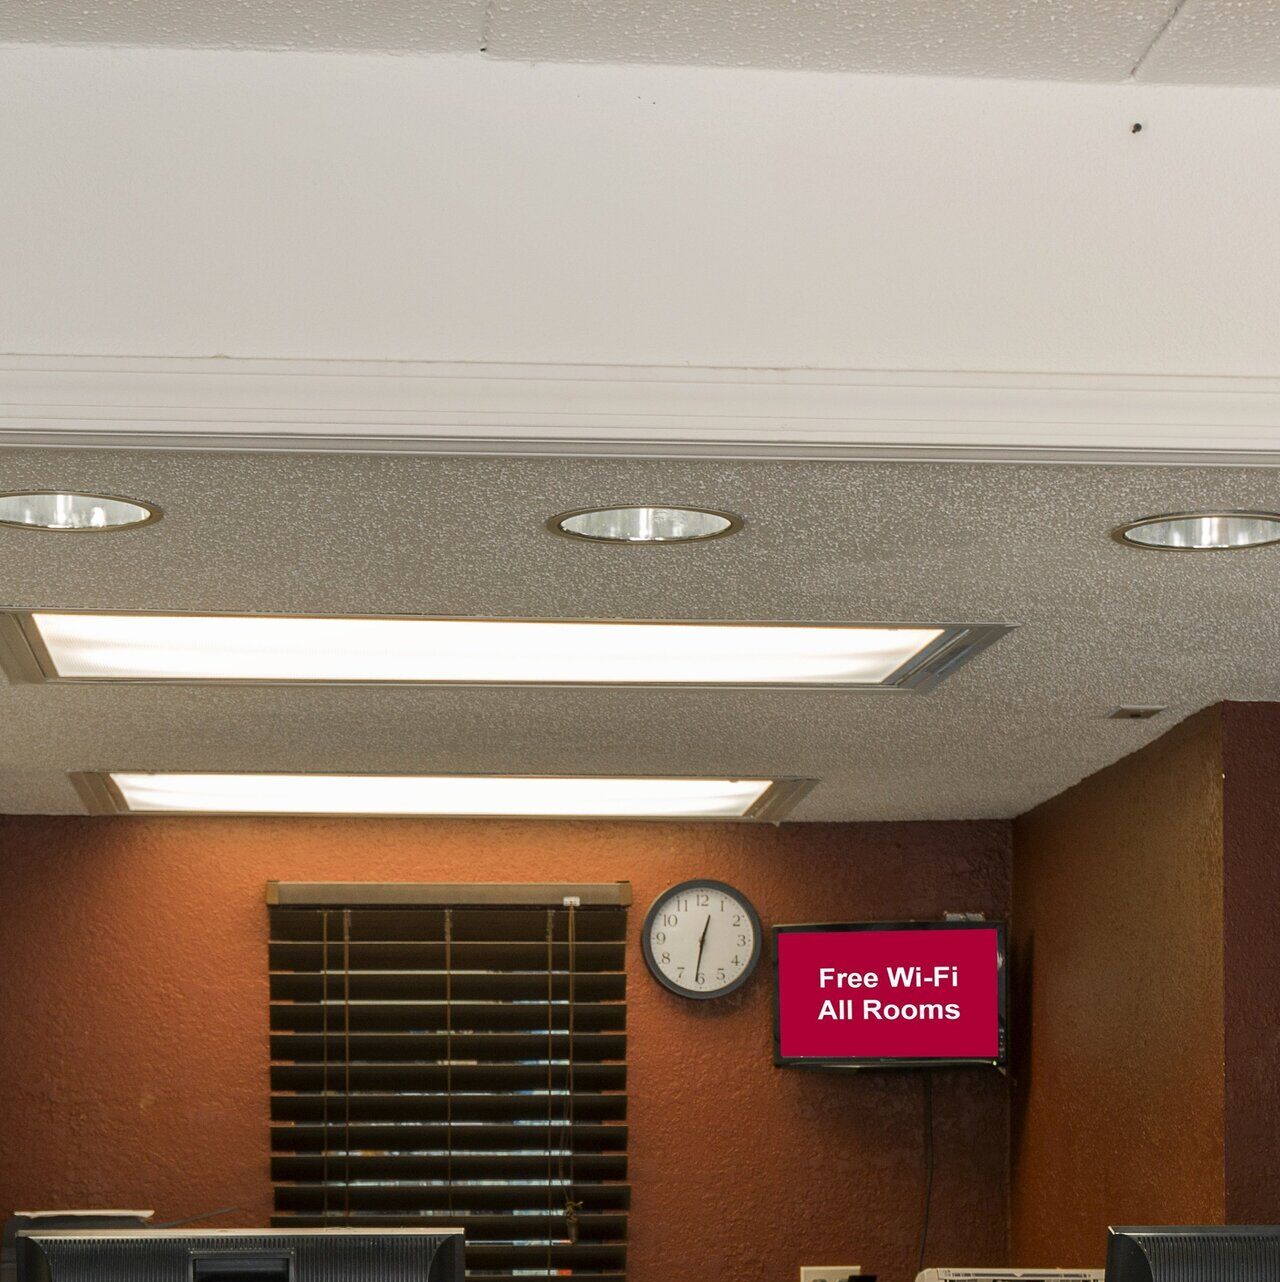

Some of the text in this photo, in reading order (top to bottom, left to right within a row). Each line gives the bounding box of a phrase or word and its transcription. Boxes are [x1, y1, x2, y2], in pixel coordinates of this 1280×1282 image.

[677, 899, 688, 912] 11
[696, 894, 709, 907] 12
[663, 914, 678, 927] 10
[732, 914, 741, 927] 2
[656, 932, 666, 945] 9
[737, 934, 746, 947] 3
[661, 952, 671, 964] 8
[731, 954, 740, 966] 4
[677, 967, 685, 979] 7
[716, 968, 726, 981] 5
[819, 966, 958, 988] Free Wi-Fi
[818, 999, 961, 1020] All Rooms
